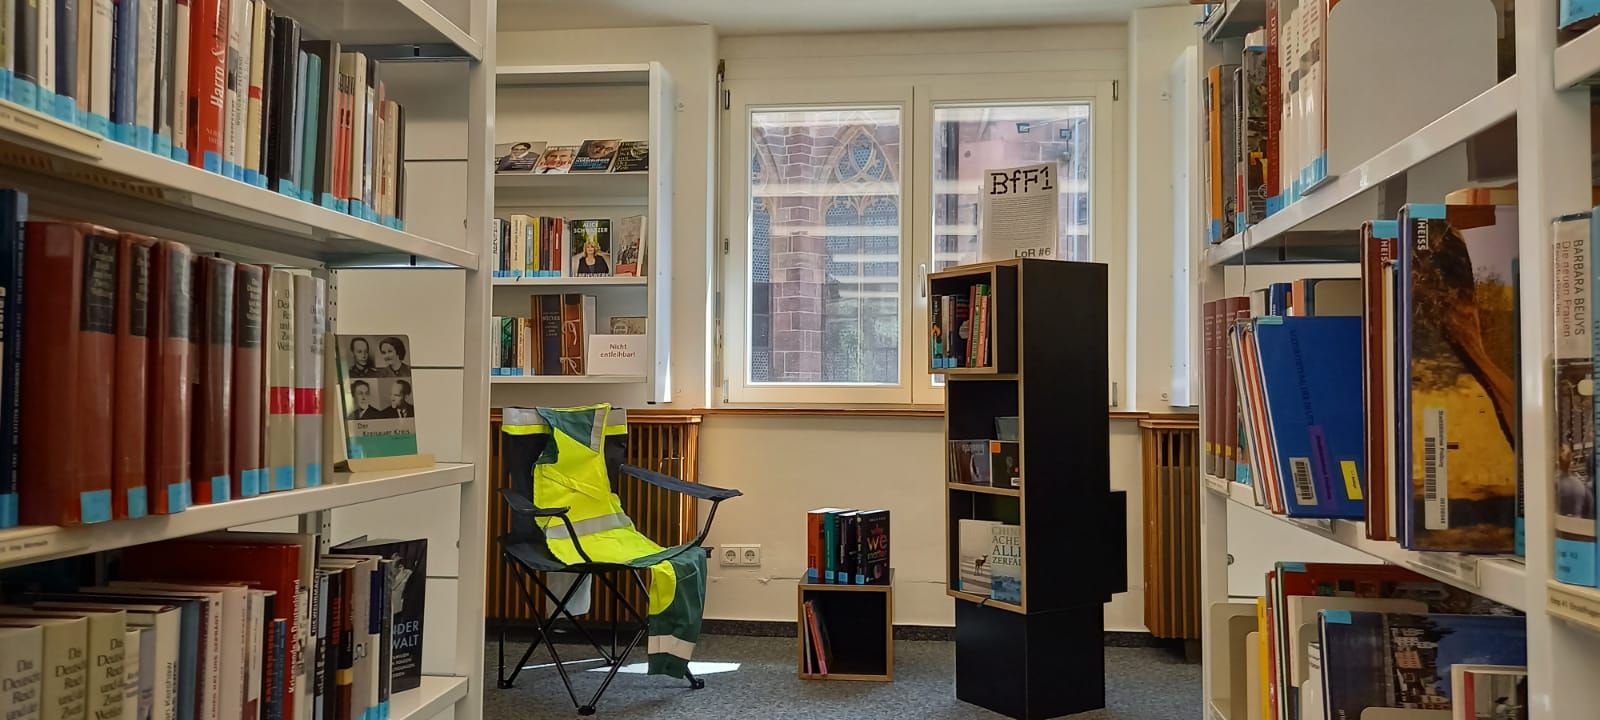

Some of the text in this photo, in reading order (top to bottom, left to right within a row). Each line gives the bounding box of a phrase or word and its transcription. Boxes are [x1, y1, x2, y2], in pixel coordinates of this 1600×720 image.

[209, 65, 225, 109] Harro
[989, 166, 1053, 195] BfF1
[1417, 217, 1428, 251] THEISS
[1014, 247, 1052, 258] LoR #6
[1380, 238, 1391, 265] HEIS
[1562, 241, 1572, 337] Die neuen Frauen
[1573, 239, 1585, 336] BARBARA BEUYS
[992, 535, 1020, 546] ACHE
[288, 579, 300, 693] Kriegsende in Deutschland
[393, 634, 420, 649] WALT
